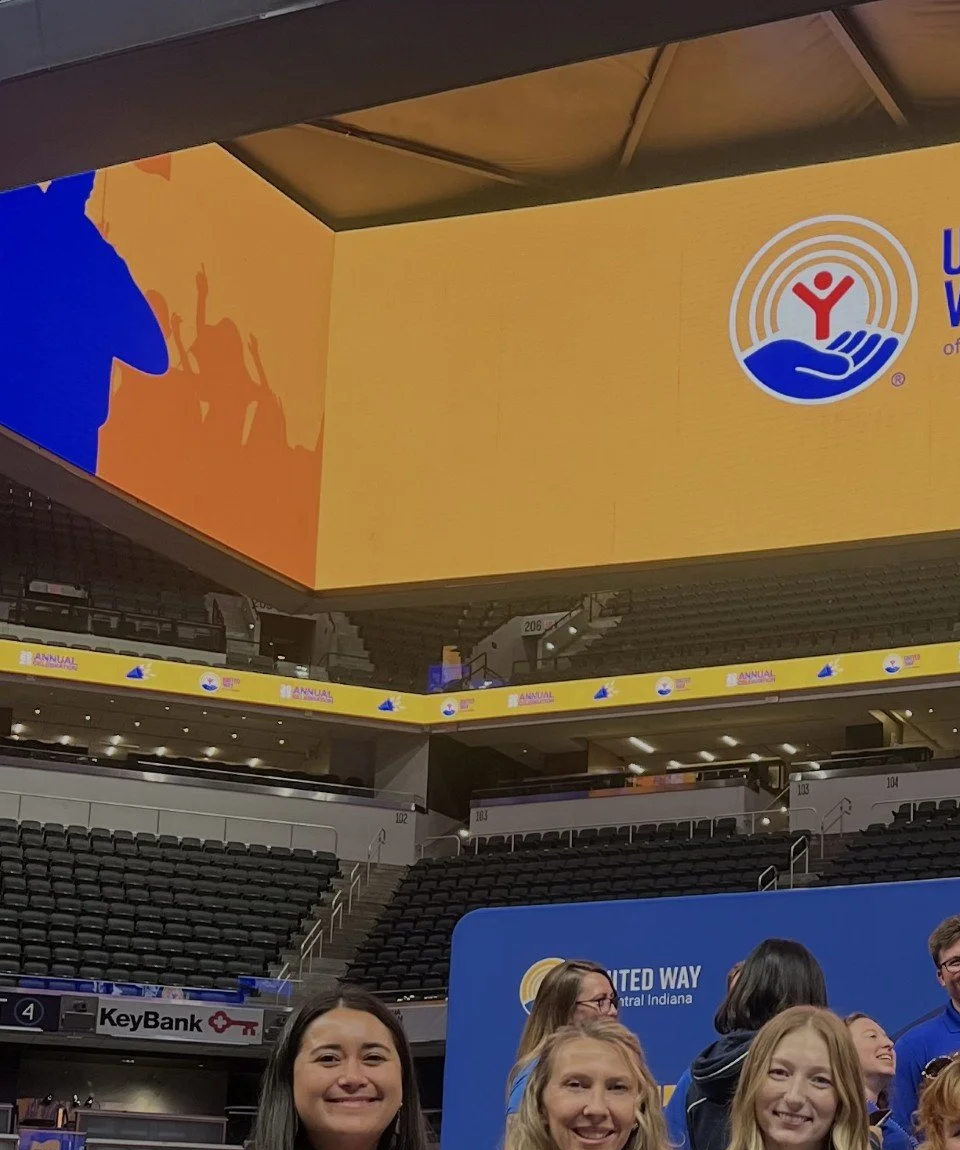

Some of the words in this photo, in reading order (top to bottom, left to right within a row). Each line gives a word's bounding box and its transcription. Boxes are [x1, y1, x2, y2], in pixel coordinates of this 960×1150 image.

[524, 619, 542, 633] 206
[33, 652, 77, 665] ANNUAL
[738, 670, 776, 680] ANNUAL
[293, 686, 333, 698] ANNUAL
[519, 691, 554, 700] ANNUAL
[886, 776, 899, 789] 104
[798, 783, 810, 796] 103
[395, 812, 409, 825] 102
[475, 810, 488, 822] 103
[659, 964, 702, 990] WAY
[648, 992, 693, 1006] Indiana
[22, 1003, 34, 1021] 4
[100, 1007, 203, 1033] KeyBank
